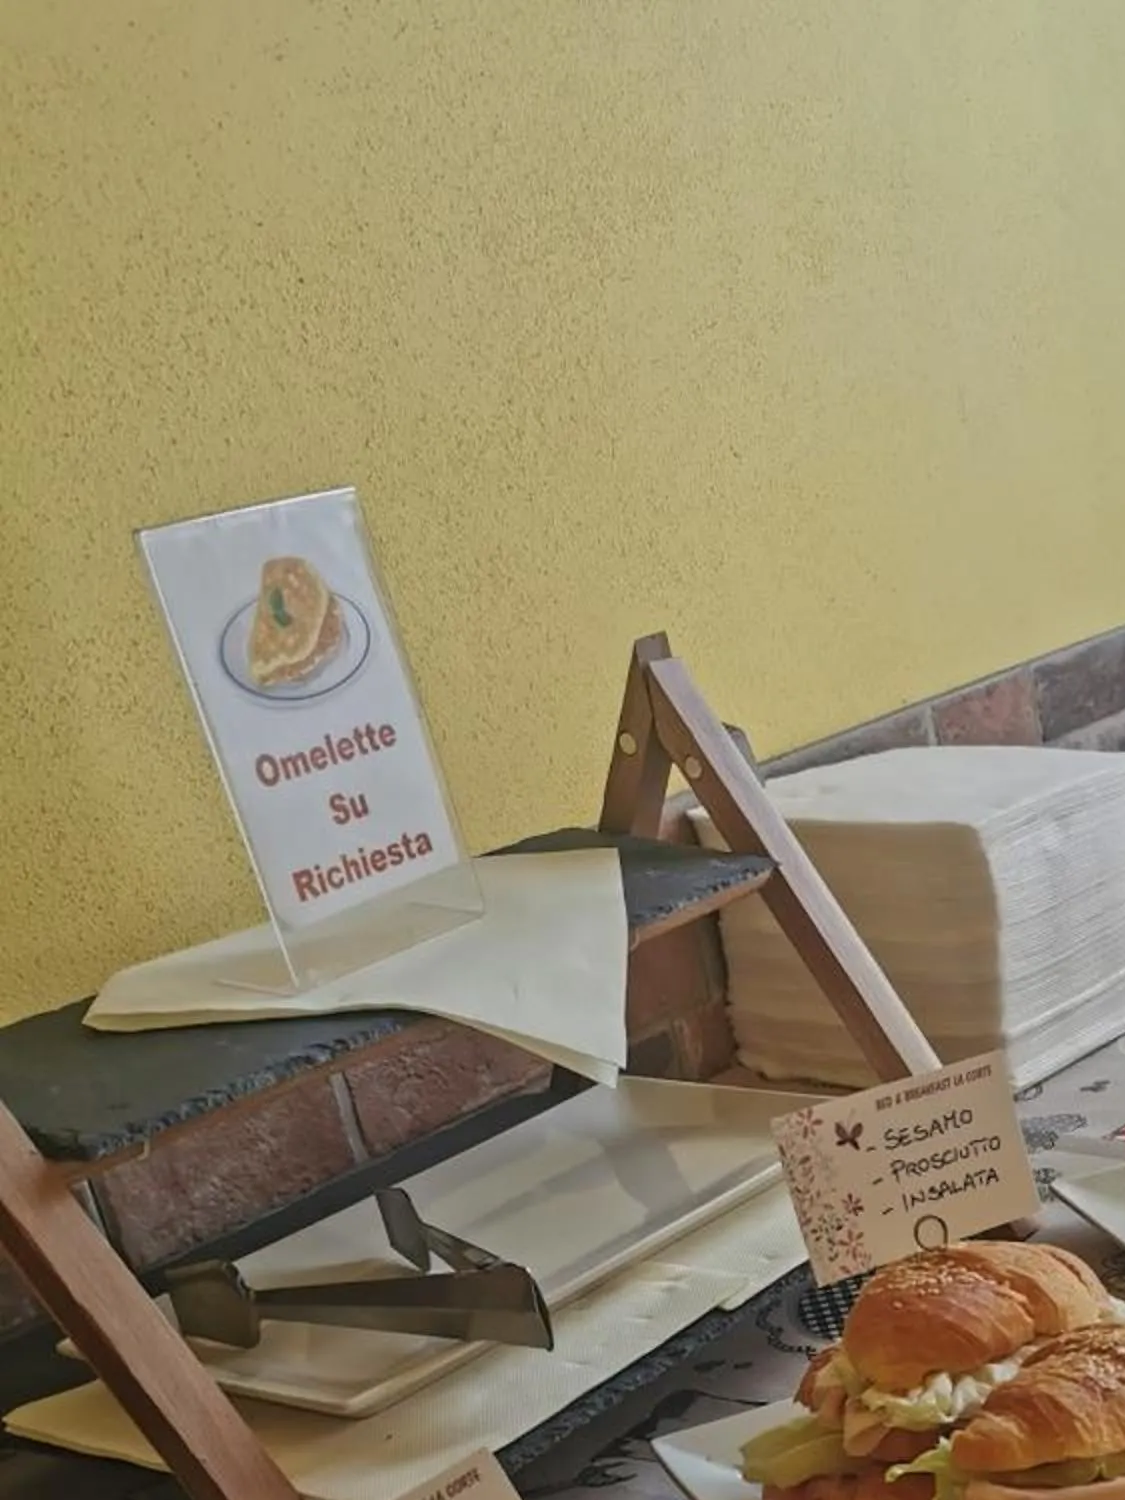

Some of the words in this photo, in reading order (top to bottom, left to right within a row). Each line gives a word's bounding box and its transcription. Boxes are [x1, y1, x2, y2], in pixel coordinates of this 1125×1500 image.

[255, 723, 396, 787] Omelette
[329, 793, 369, 825] Su
[291, 831, 433, 902] Richiesta
[884, 1108, 973, 1151] SESAMO
[890, 1135, 1001, 1183] PROSCIUTTO
[902, 1167, 1000, 1212] INSALATA
